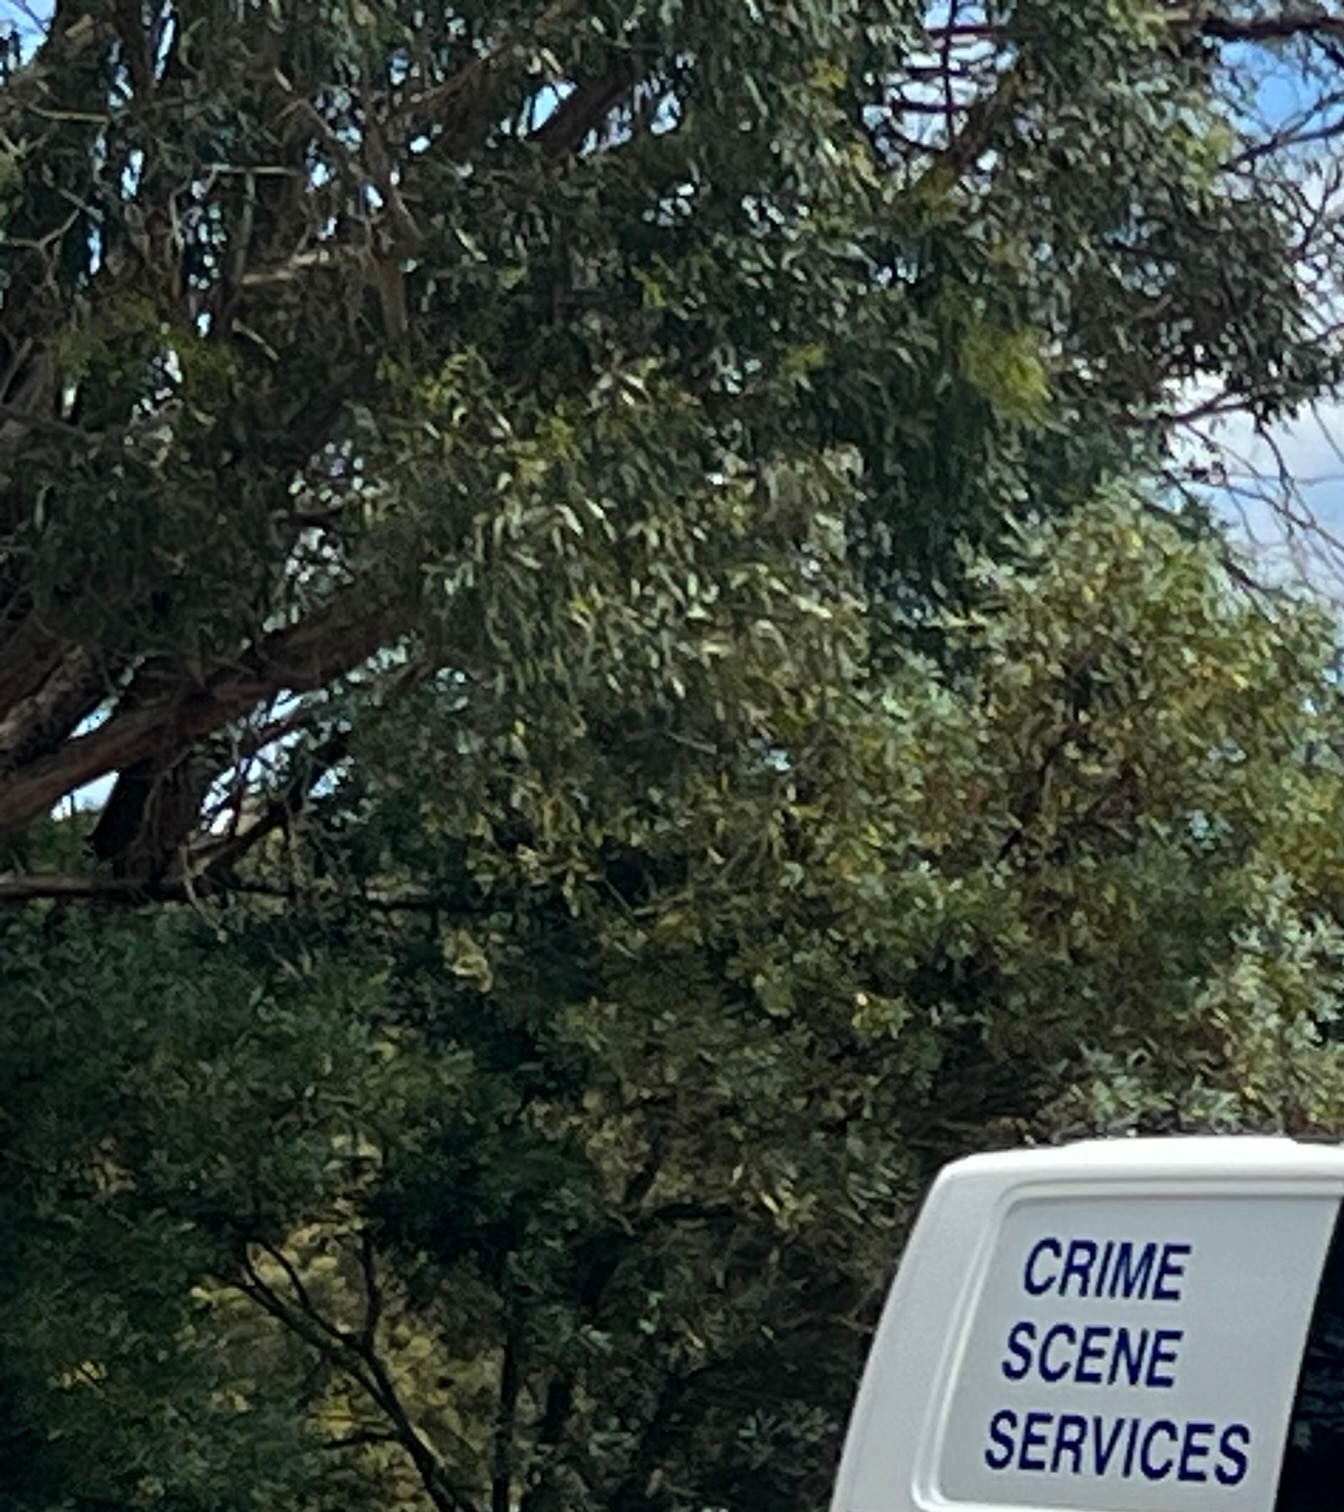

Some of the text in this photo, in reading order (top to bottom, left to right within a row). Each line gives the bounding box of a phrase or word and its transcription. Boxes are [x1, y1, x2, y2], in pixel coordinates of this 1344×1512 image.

[1023, 1236, 1192, 1300] CRIME
[1001, 1321, 1184, 1388] SCENE
[984, 1408, 1251, 1486] SERVICES
